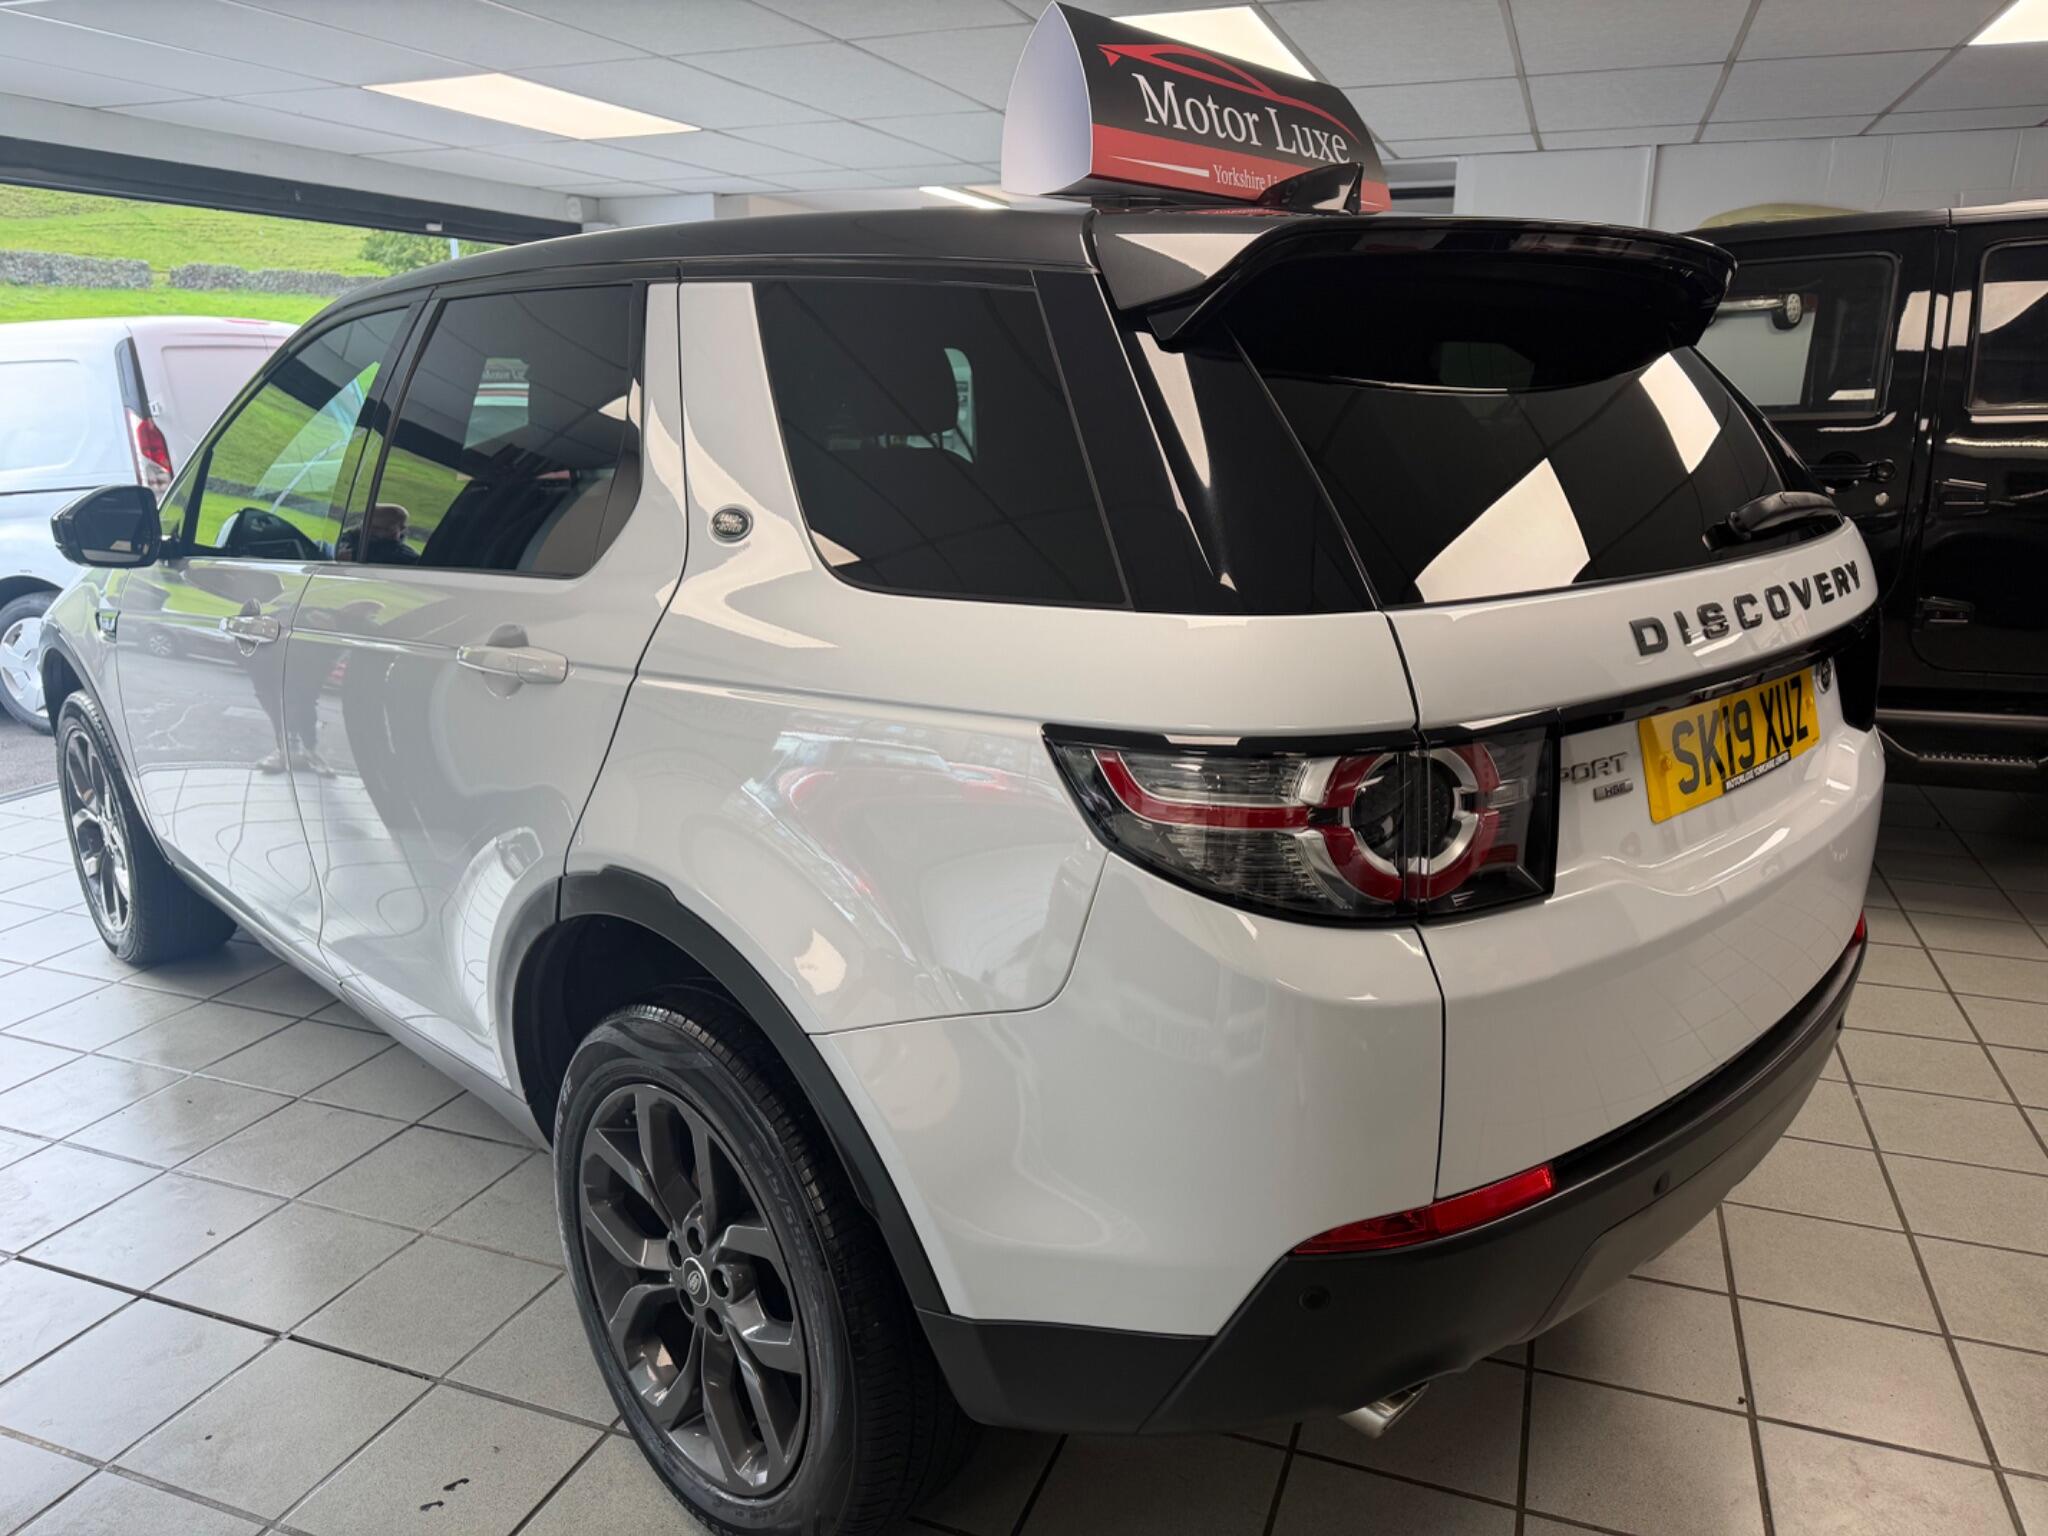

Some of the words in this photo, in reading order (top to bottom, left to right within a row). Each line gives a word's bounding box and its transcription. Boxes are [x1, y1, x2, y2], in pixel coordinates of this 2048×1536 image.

[1131, 72, 1262, 146] Motor
[1265, 106, 1351, 164] Luxe
[1212, 163, 1266, 191] Yorkshire
[1628, 560, 1861, 656] DISCOVERY
[1671, 699, 1755, 795] SK19
[1759, 675, 1809, 761] XUZ
